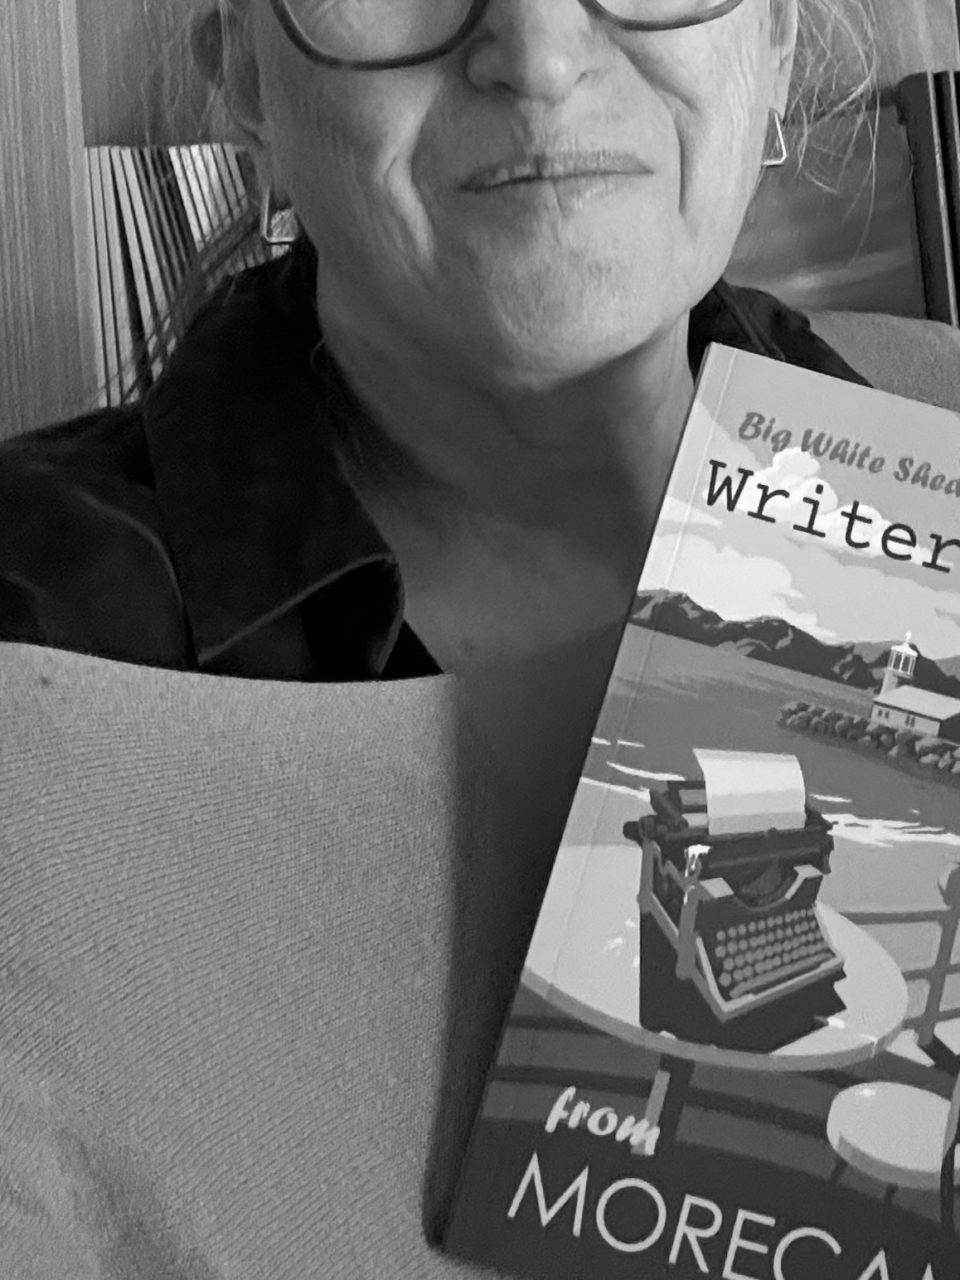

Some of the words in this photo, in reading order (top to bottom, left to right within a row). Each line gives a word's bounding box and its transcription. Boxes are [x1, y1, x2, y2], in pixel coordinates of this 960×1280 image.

[738, 412, 793, 453] Big
[800, 428, 885, 473] White
[545, 1085, 661, 1156] from
